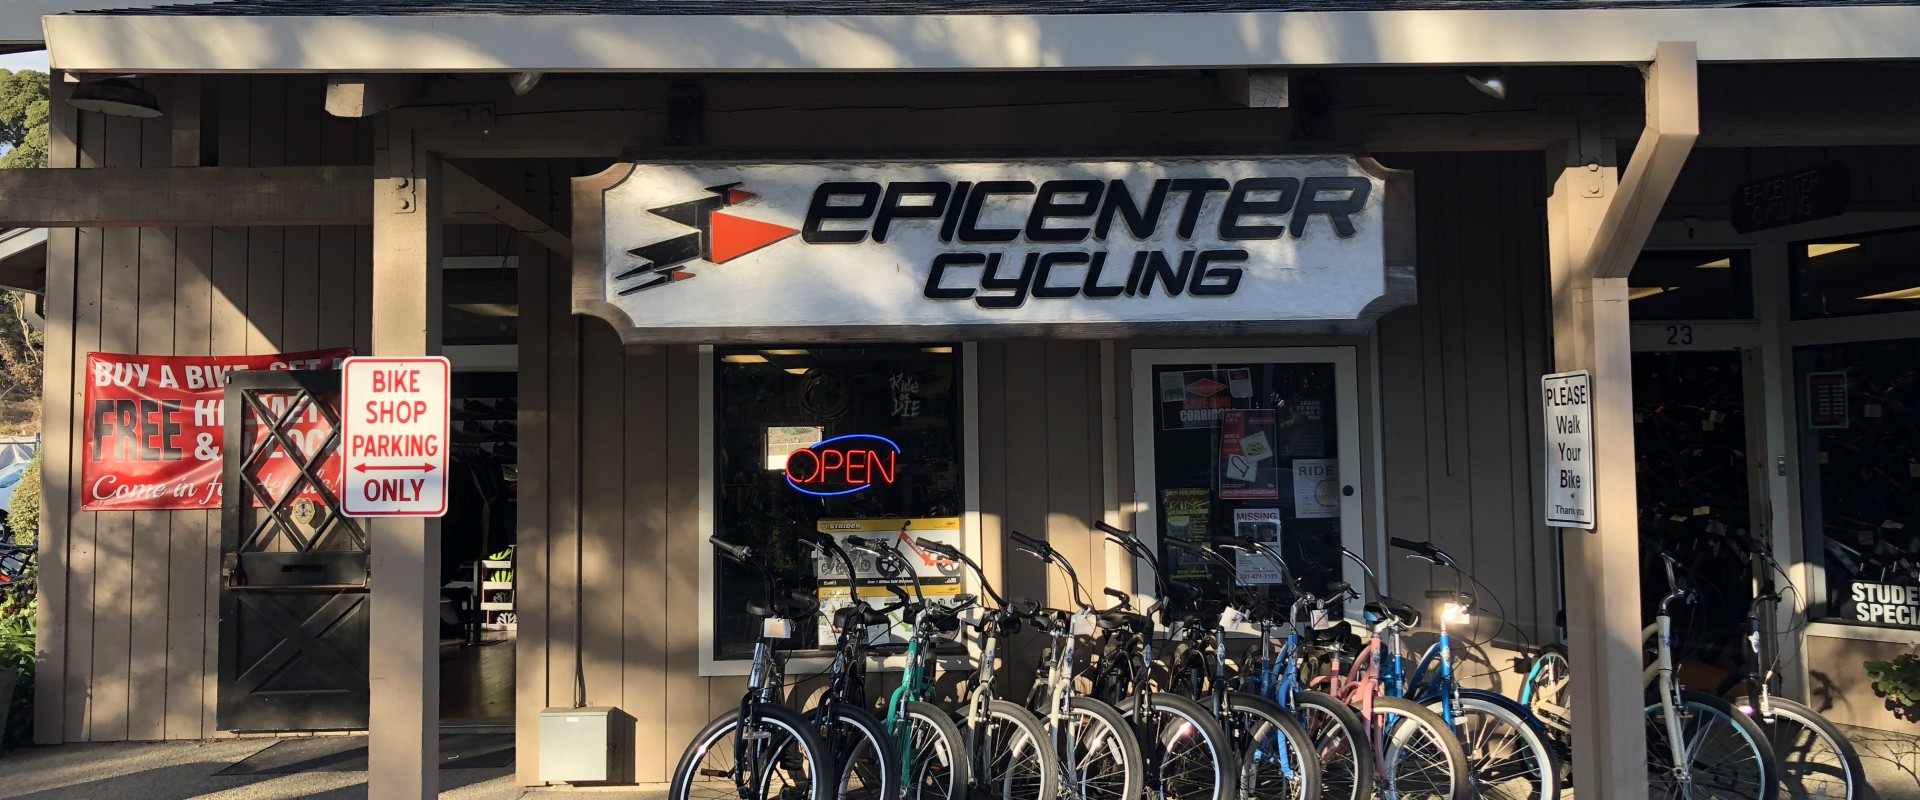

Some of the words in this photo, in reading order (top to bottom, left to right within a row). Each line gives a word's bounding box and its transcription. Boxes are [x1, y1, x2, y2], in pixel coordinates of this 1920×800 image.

[801, 177, 1373, 244] EPICENTER
[923, 249, 1250, 309] CYCLING
[1666, 324, 1693, 346] 23
[95, 361, 150, 388] BUY
[159, 364, 180, 389] A
[185, 364, 250, 390] BIK
[372, 370, 421, 394] BIKE
[891, 399, 921, 417] DIE
[1546, 385, 1586, 407] PLEASE
[365, 400, 428, 424] SHOP
[92, 398, 183, 463] FREE
[1556, 415, 1581, 434] Walk
[194, 432, 220, 461] &
[352, 434, 439, 458] PARKING
[1557, 442, 1581, 463] Your
[785, 447, 897, 485] OPEN
[1298, 465, 1335, 476] RIDE
[92, 474, 168, 501] Come
[174, 477, 198, 498] in
[363, 478, 426, 503] ONLY
[1559, 468, 1581, 490] Bike
[1236, 512, 1278, 521] MISSING
[1851, 582, 1920, 606] STUDE
